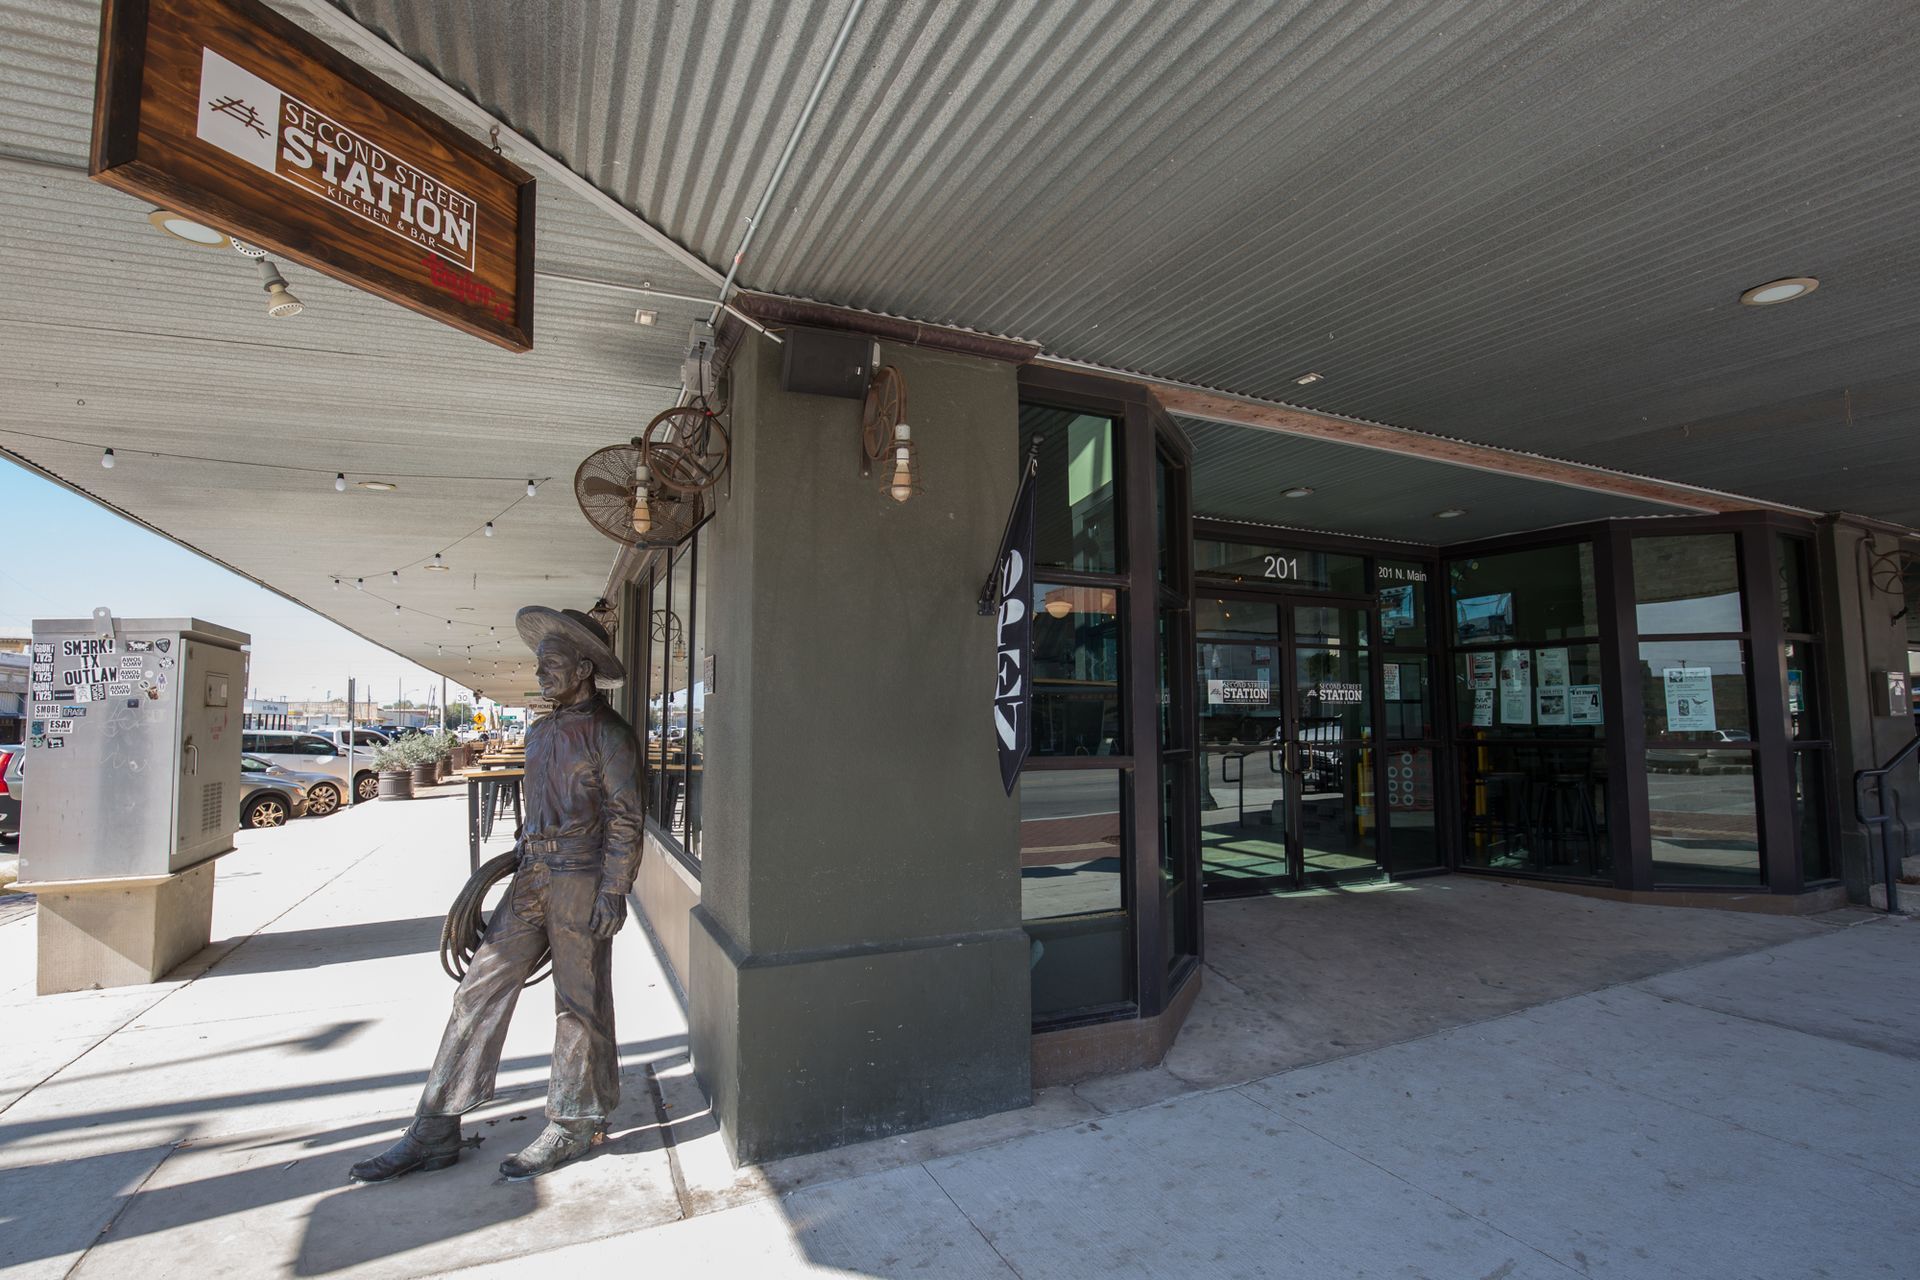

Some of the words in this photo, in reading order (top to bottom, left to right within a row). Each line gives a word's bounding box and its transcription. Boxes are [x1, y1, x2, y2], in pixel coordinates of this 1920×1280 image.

[284, 102, 386, 170] SECOND
[395, 165, 472, 219] STREET
[282, 126, 472, 251] STATION
[327, 185, 390, 224] KITCHEN
[397, 220, 406, 231] &
[410, 227, 437, 248] BAR
[1264, 556, 1297, 580] 201
[1378, 566, 1393, 579] 201
[1395, 567, 1406, 580] N.
[1407, 569, 1427, 582] Main
[994, 549, 1025, 751] OPEN
[81, 655, 99, 668] TX
[64, 667, 118, 686] OUTLAW
[1223, 688, 1268, 699] STATION
[1319, 689, 1362, 701] STATION
[50, 720, 72, 728] ESAY
